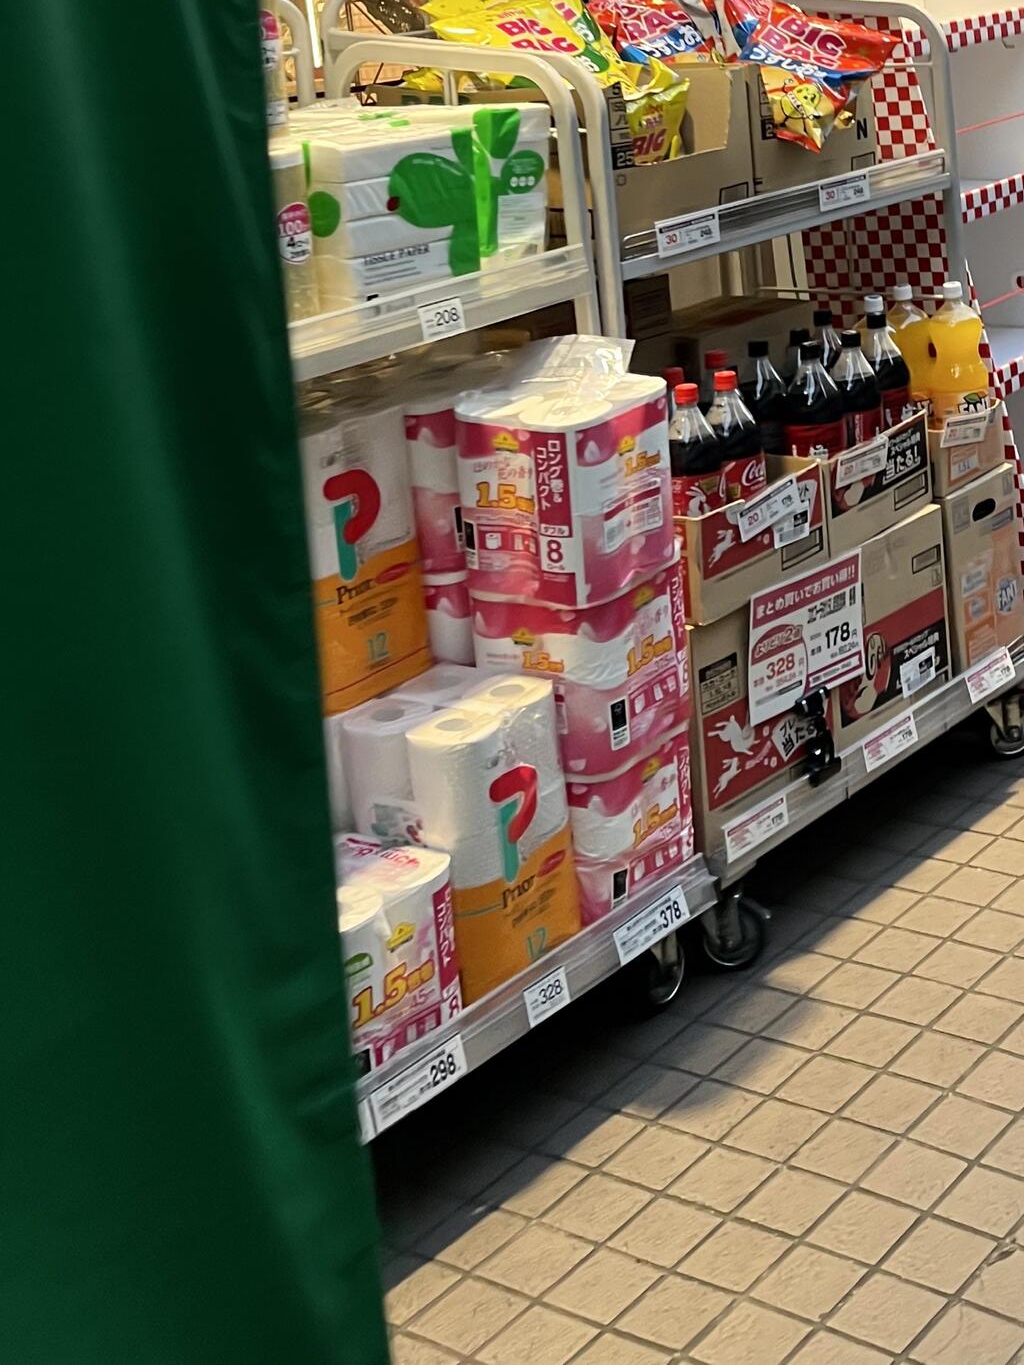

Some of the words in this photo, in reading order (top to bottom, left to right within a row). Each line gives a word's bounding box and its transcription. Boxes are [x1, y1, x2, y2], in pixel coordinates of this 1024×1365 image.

[495, 17, 553, 37] BIG
[779, 16, 847, 60] BIG
[434, 306, 460, 327] 208
[536, 447, 551, 511] コンパクト
[825, 622, 850, 659] 178
[766, 652, 795, 680] 328
[660, 900, 682, 929] 378
[538, 979, 564, 1005] 328
[430, 1053, 456, 1087] 298
